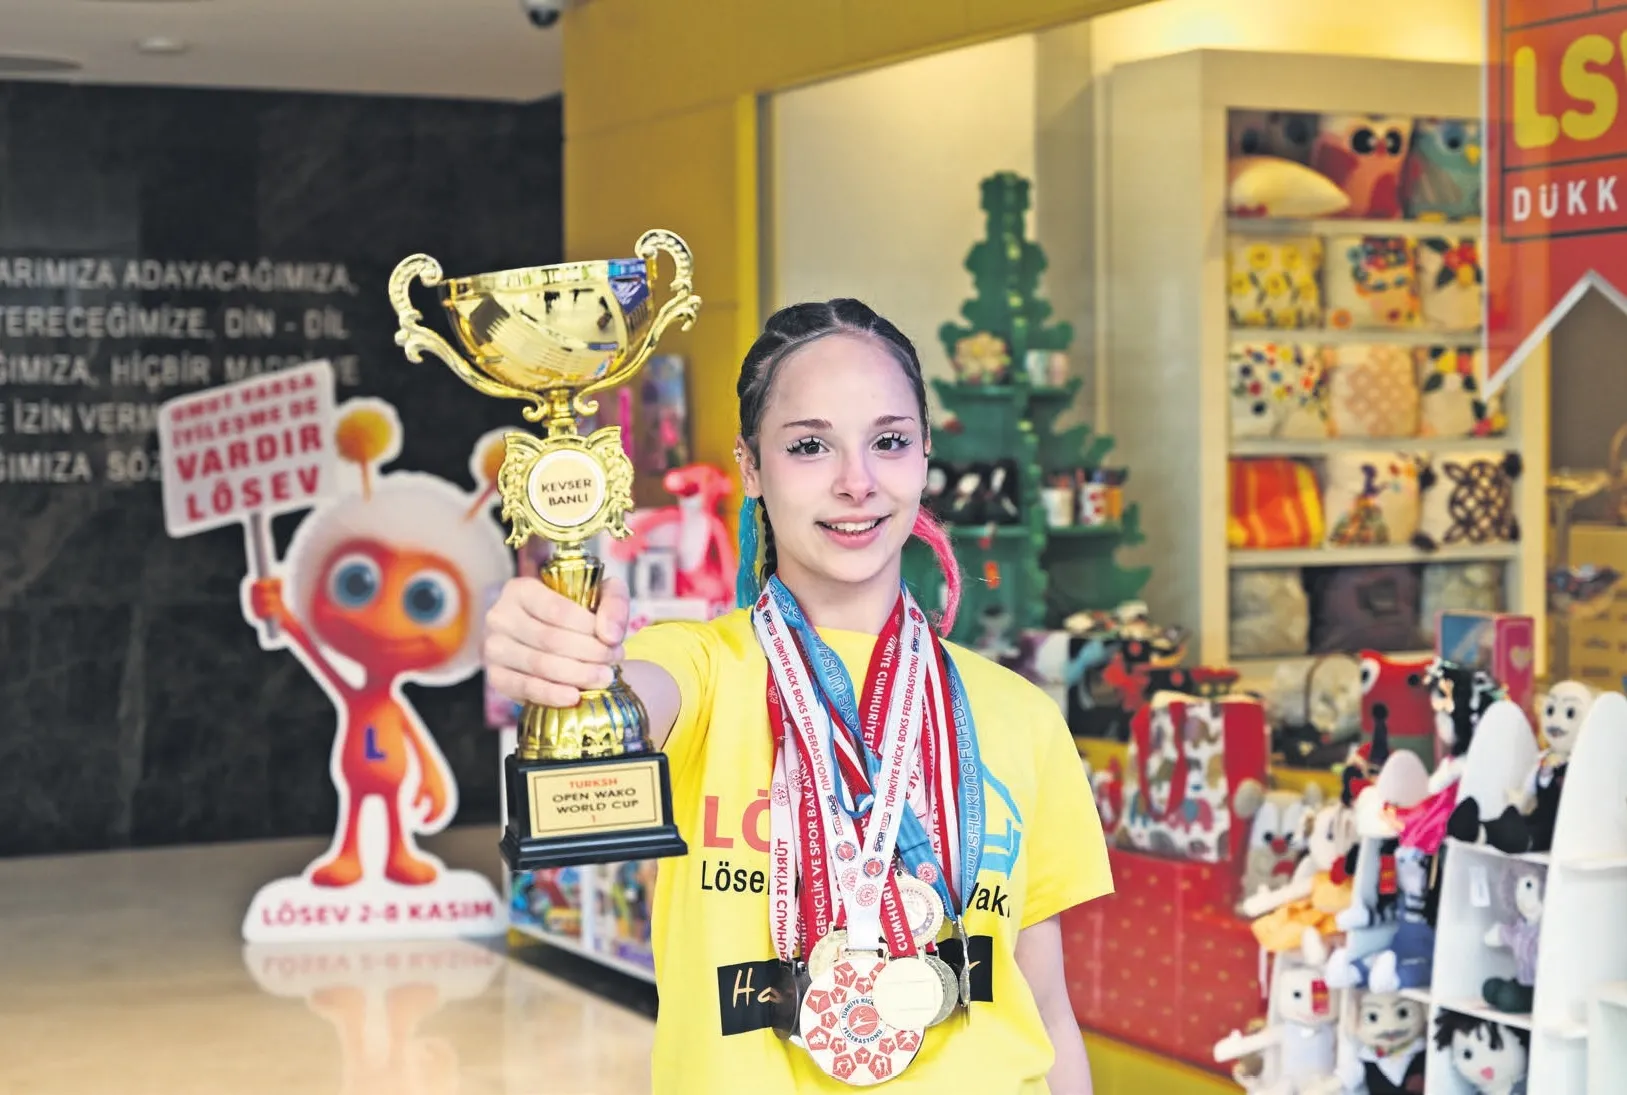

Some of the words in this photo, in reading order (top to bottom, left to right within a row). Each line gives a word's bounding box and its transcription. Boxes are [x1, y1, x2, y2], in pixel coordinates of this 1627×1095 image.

[1513, 29, 1627, 150] LS
[289, 397, 318, 418] DE
[176, 423, 322, 483] VARDIR
[187, 465, 320, 522] LÖSEV
[541, 478, 592, 493] KEVSER
[548, 493, 588, 507] BANLI
[773, 636, 791, 667] TÜRKİYE
[793, 688, 808, 714] BOKS
[802, 715, 831, 791] FEDERASYONU
[864, 671, 888, 749] CUMHURİYET
[885, 767, 900, 808] TÜRKİYE
[897, 718, 909, 742] BOKS
[903, 654, 919, 717] FEDERASYONU
[958, 739, 976, 760] FU
[552, 792, 589, 803] OPEN
[594, 787, 636, 799] WAKO
[569, 778, 618, 789] TURKSH
[556, 802, 606, 814] WORLD
[612, 799, 639, 809] CUP
[808, 820, 820, 856] SPOR
[701, 860, 770, 896] Löse
[811, 859, 822, 877] VE
[261, 900, 350, 926] LÖSEV
[408, 900, 496, 921] KASIM
[811, 879, 828, 936] GENÇLİK
